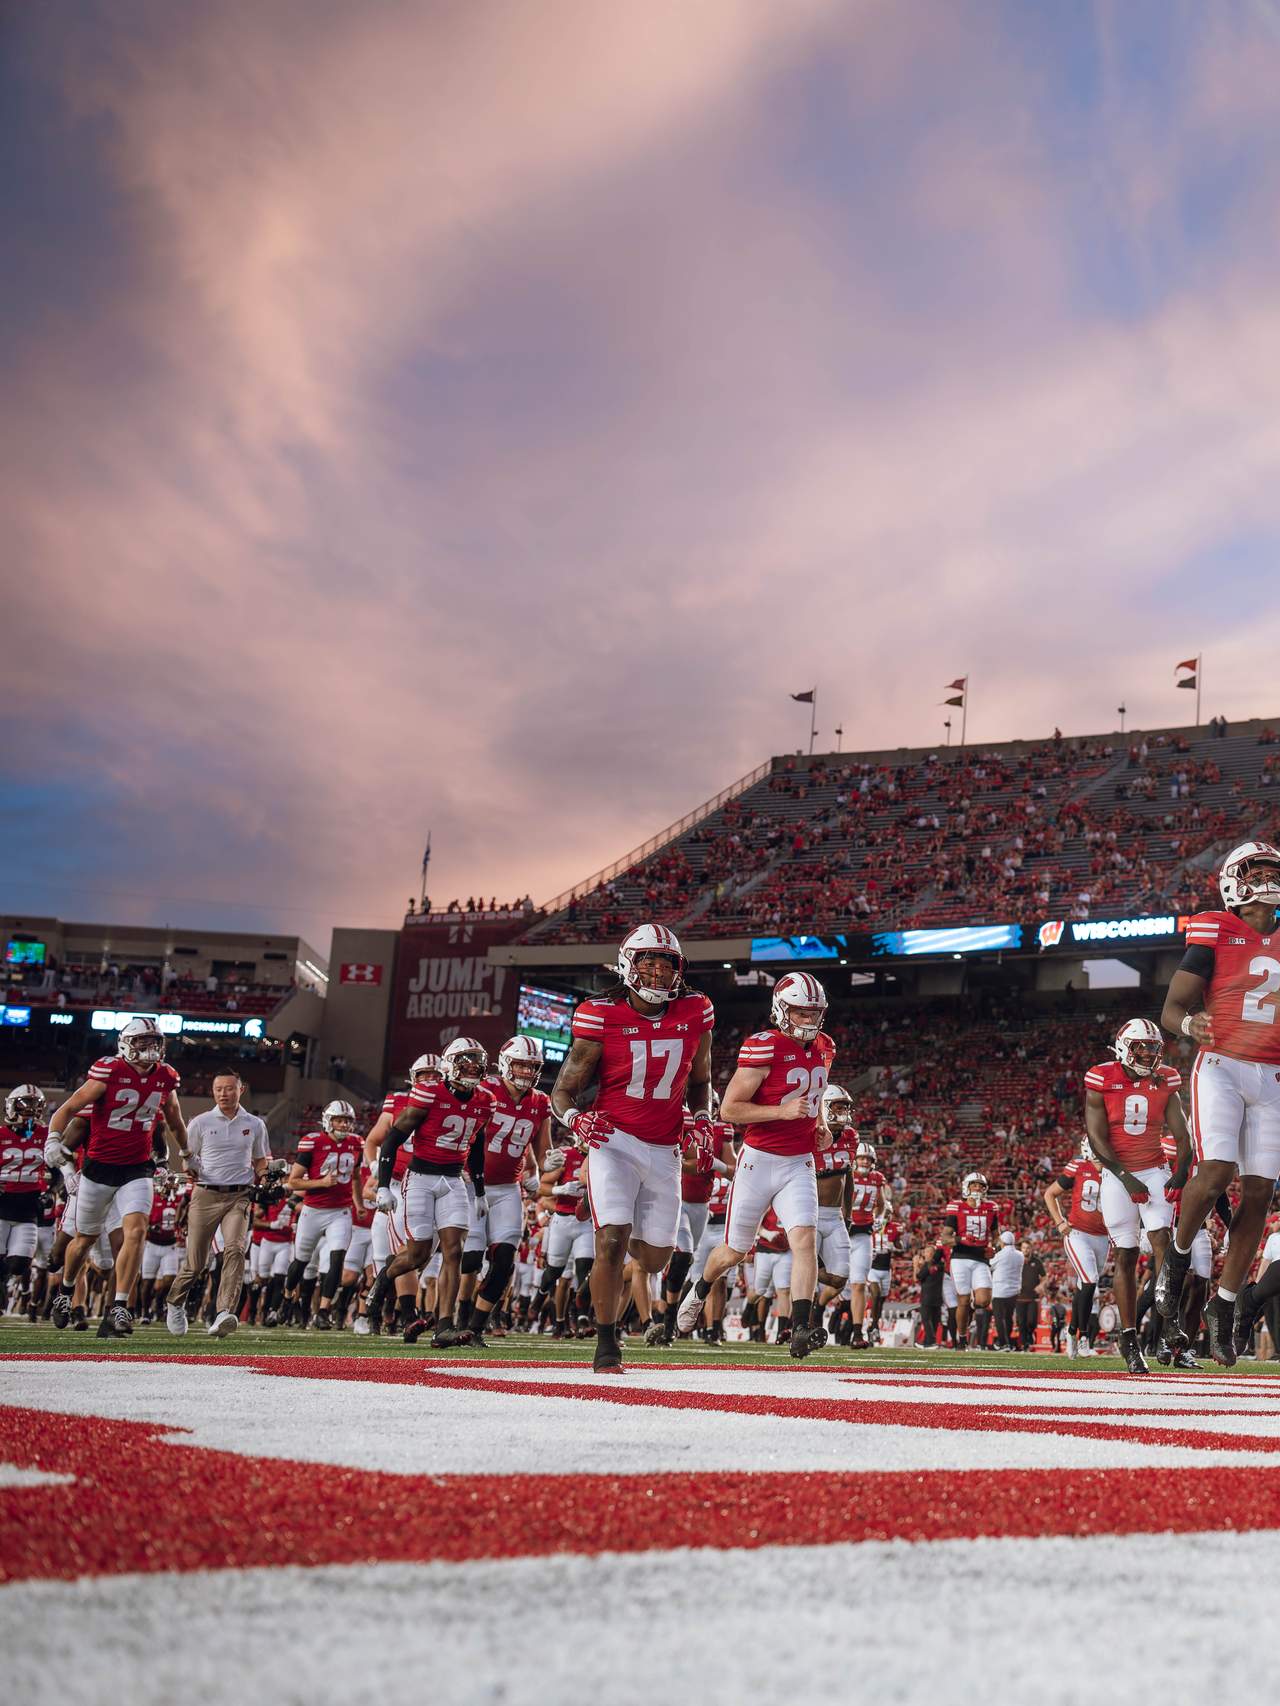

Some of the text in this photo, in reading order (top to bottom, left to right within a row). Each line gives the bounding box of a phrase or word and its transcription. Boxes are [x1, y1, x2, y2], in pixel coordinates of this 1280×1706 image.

[1071, 916, 1175, 941] WISCONSIN
[50, 1014, 73, 1025] FAU
[182, 1020, 242, 1036] MICHIGAN ST
[625, 1038, 684, 1100] 17
[780, 1066, 828, 1118] 28
[107, 1088, 163, 1132] 24
[1123, 1094, 1149, 1136] 8
[435, 1114, 477, 1151] 21
[487, 1111, 535, 1159] 79
[0, 1147, 44, 1183] 22
[320, 1151, 357, 1185] 49
[851, 1183, 878, 1212] 77
[1080, 1179, 1103, 1213] 9
[966, 1215, 987, 1241] 51
